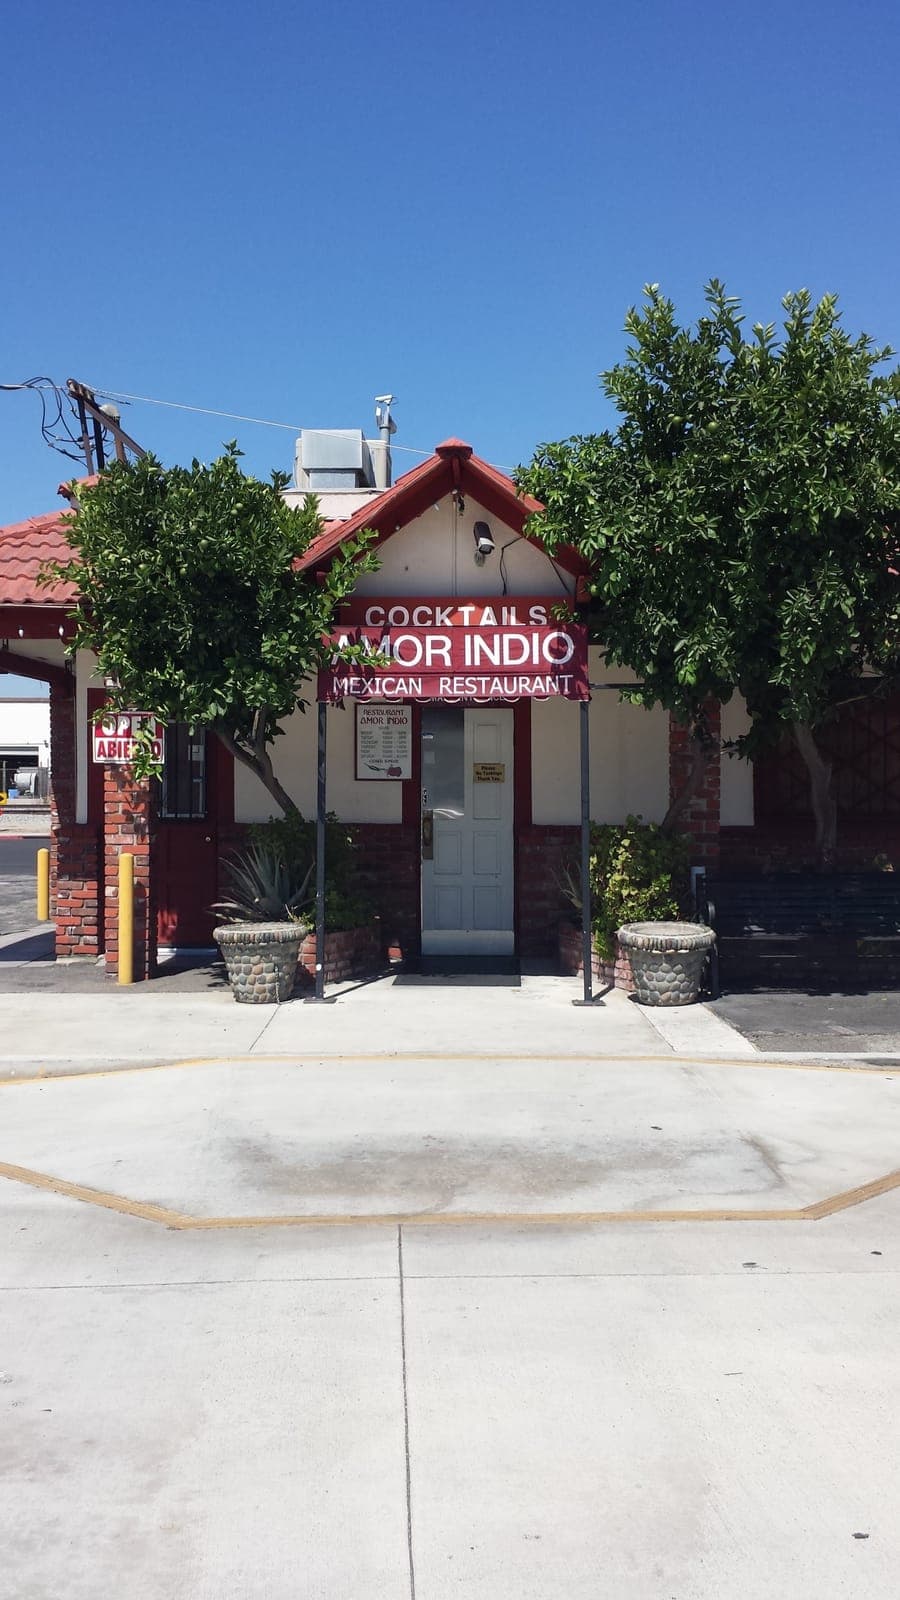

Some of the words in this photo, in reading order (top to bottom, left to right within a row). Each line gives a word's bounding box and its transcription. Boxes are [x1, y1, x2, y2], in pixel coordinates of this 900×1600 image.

[365, 606, 547, 627] COCKTAILS
[331, 634, 453, 667] AMOR
[464, 631, 575, 667] INDIO
[333, 677, 422, 695] MEXICAN
[439, 674, 574, 695] RESTAURANT
[360, 717, 384, 725] AMOR
[387, 717, 408, 725] INDIO
[363, 708, 404, 716] RESTAURANT
[97, 740, 161, 760] ABIEO
